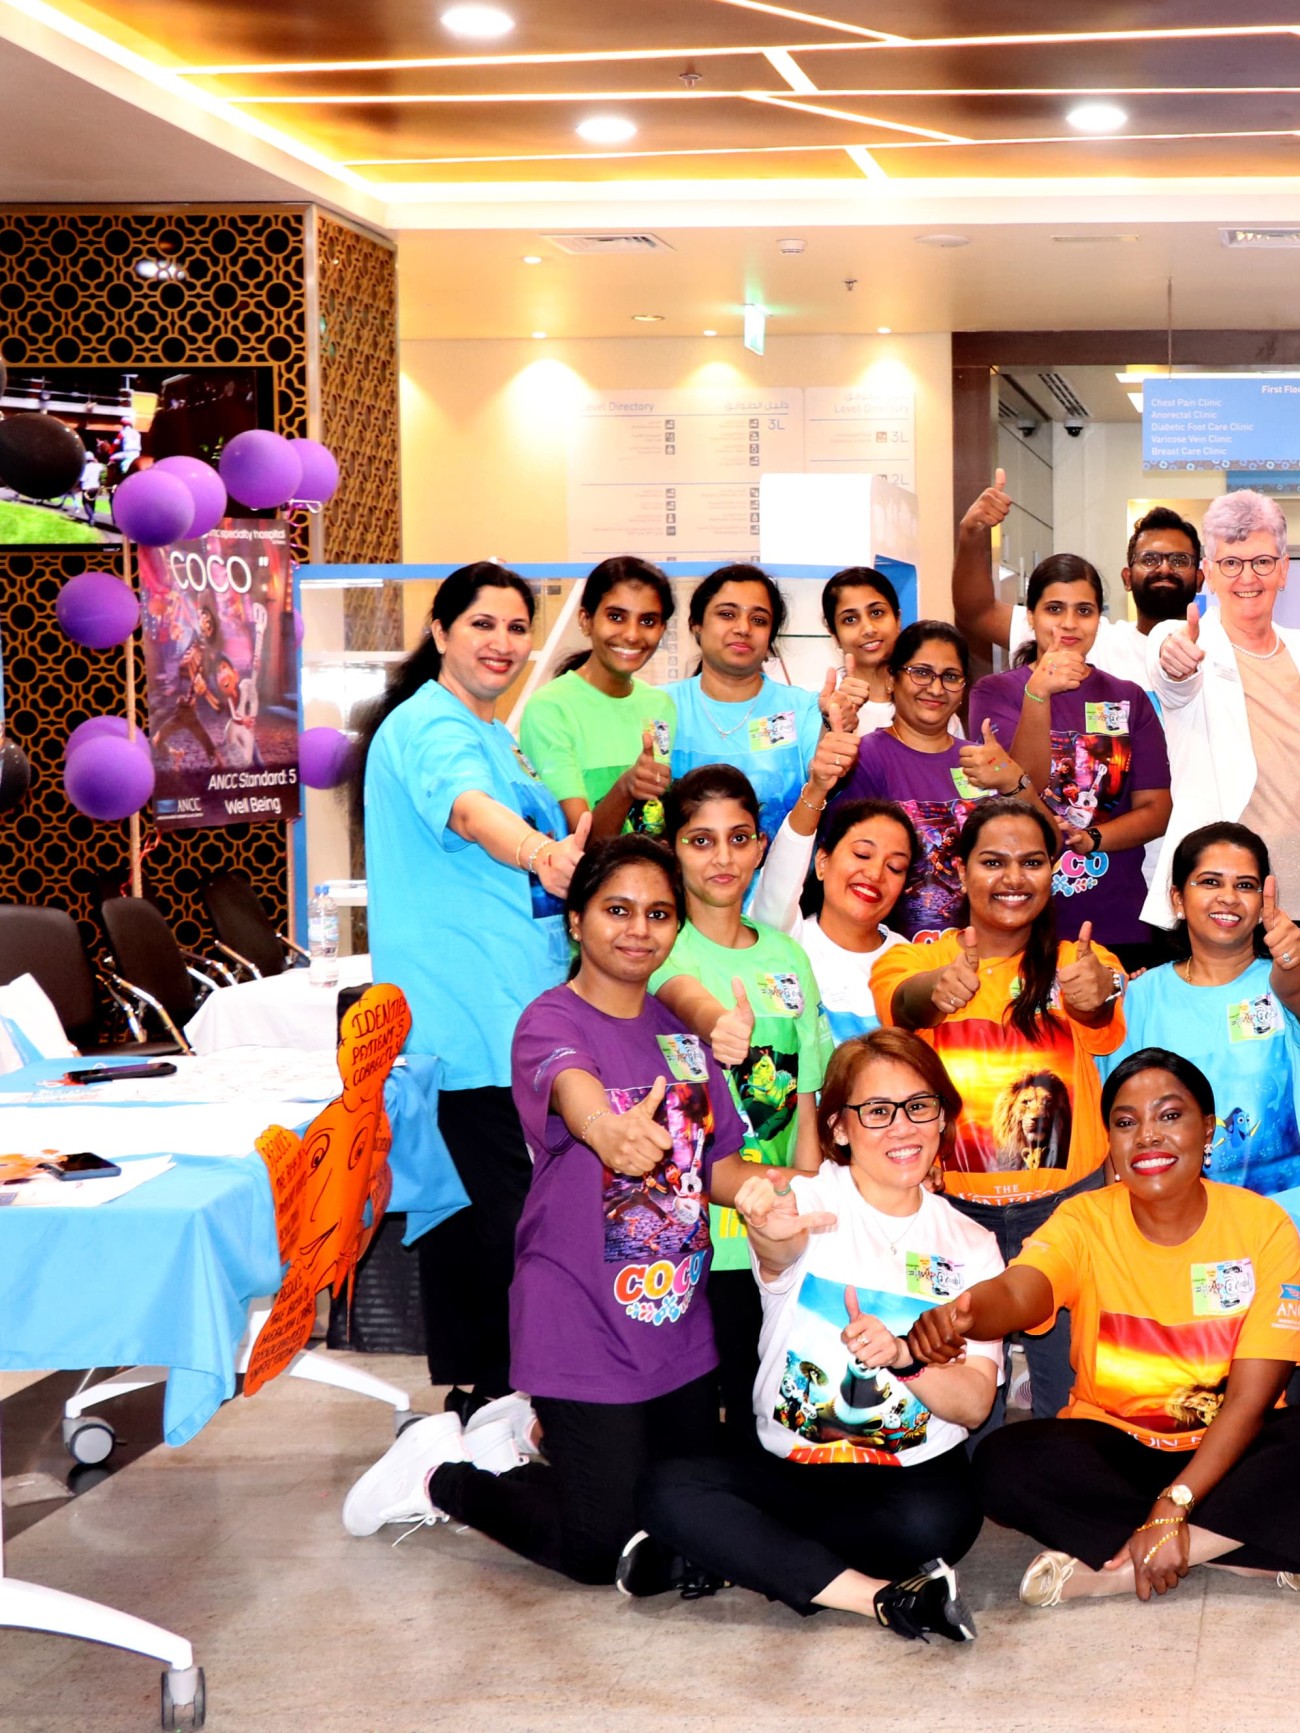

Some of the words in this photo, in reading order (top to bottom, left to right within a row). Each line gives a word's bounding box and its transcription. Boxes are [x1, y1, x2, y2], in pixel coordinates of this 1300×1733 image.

[1261, 385, 1282, 394] First
[609, 401, 655, 412] Directory
[1151, 398, 1175, 408] Chest
[1177, 398, 1196, 408] Pain
[1198, 398, 1222, 408] Clinic
[1151, 410, 1191, 419] Anorectal
[1193, 410, 1217, 419] Clinic
[768, 418, 785, 430] 3L
[1151, 422, 1185, 432] Diabetic
[1187, 422, 1206, 432] Foot
[1208, 422, 1228, 432] Care
[1230, 422, 1254, 432] Clinic
[891, 431, 909, 443] 3L
[1151, 434, 1187, 444] Varicose
[1189, 434, 1207, 444] Vein
[1208, 434, 1233, 444] Clinic
[1151, 446, 1179, 456] Breast
[1181, 446, 1201, 456] Care
[1203, 446, 1227, 456] Clinic
[253, 530, 286, 542] hospital
[170, 551, 252, 594] COCO
[208, 773, 238, 791] ANCC
[288, 768, 297, 784] 5
[176, 798, 202, 813] ANCC
[224, 798, 250, 815] Well
[251, 797, 282, 814] Being
[1053, 850, 1109, 878] CO
[994, 1184, 1019, 1194] THE
[614, 1250, 707, 1305] COCO
